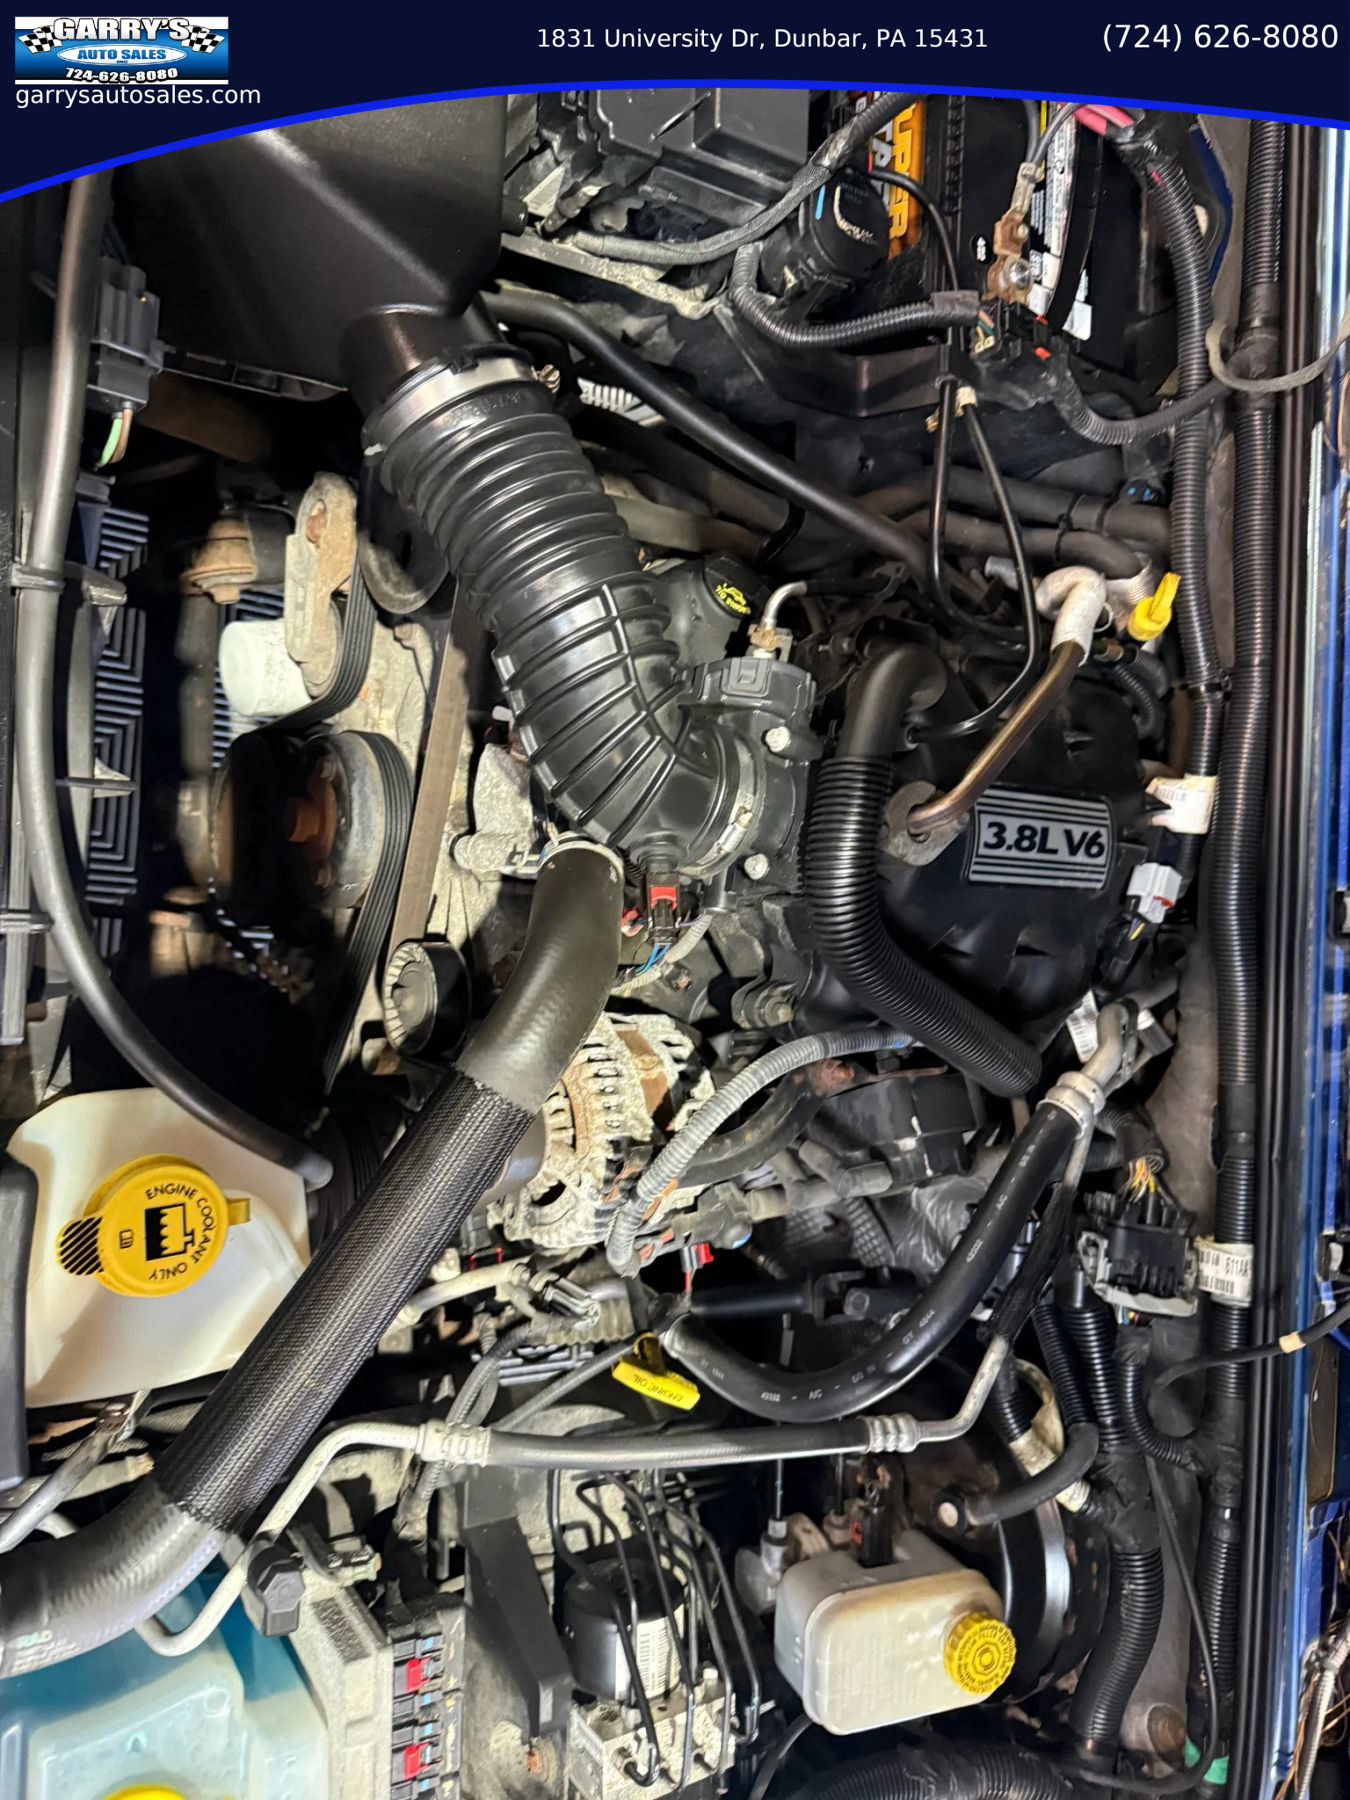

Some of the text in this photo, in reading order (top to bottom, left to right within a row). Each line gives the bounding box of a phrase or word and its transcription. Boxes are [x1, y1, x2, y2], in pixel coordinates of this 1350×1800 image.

[983, 821, 1106, 859] 3.8L V6
[145, 1182, 216, 1281] ENGINE COOLANT ONLY
